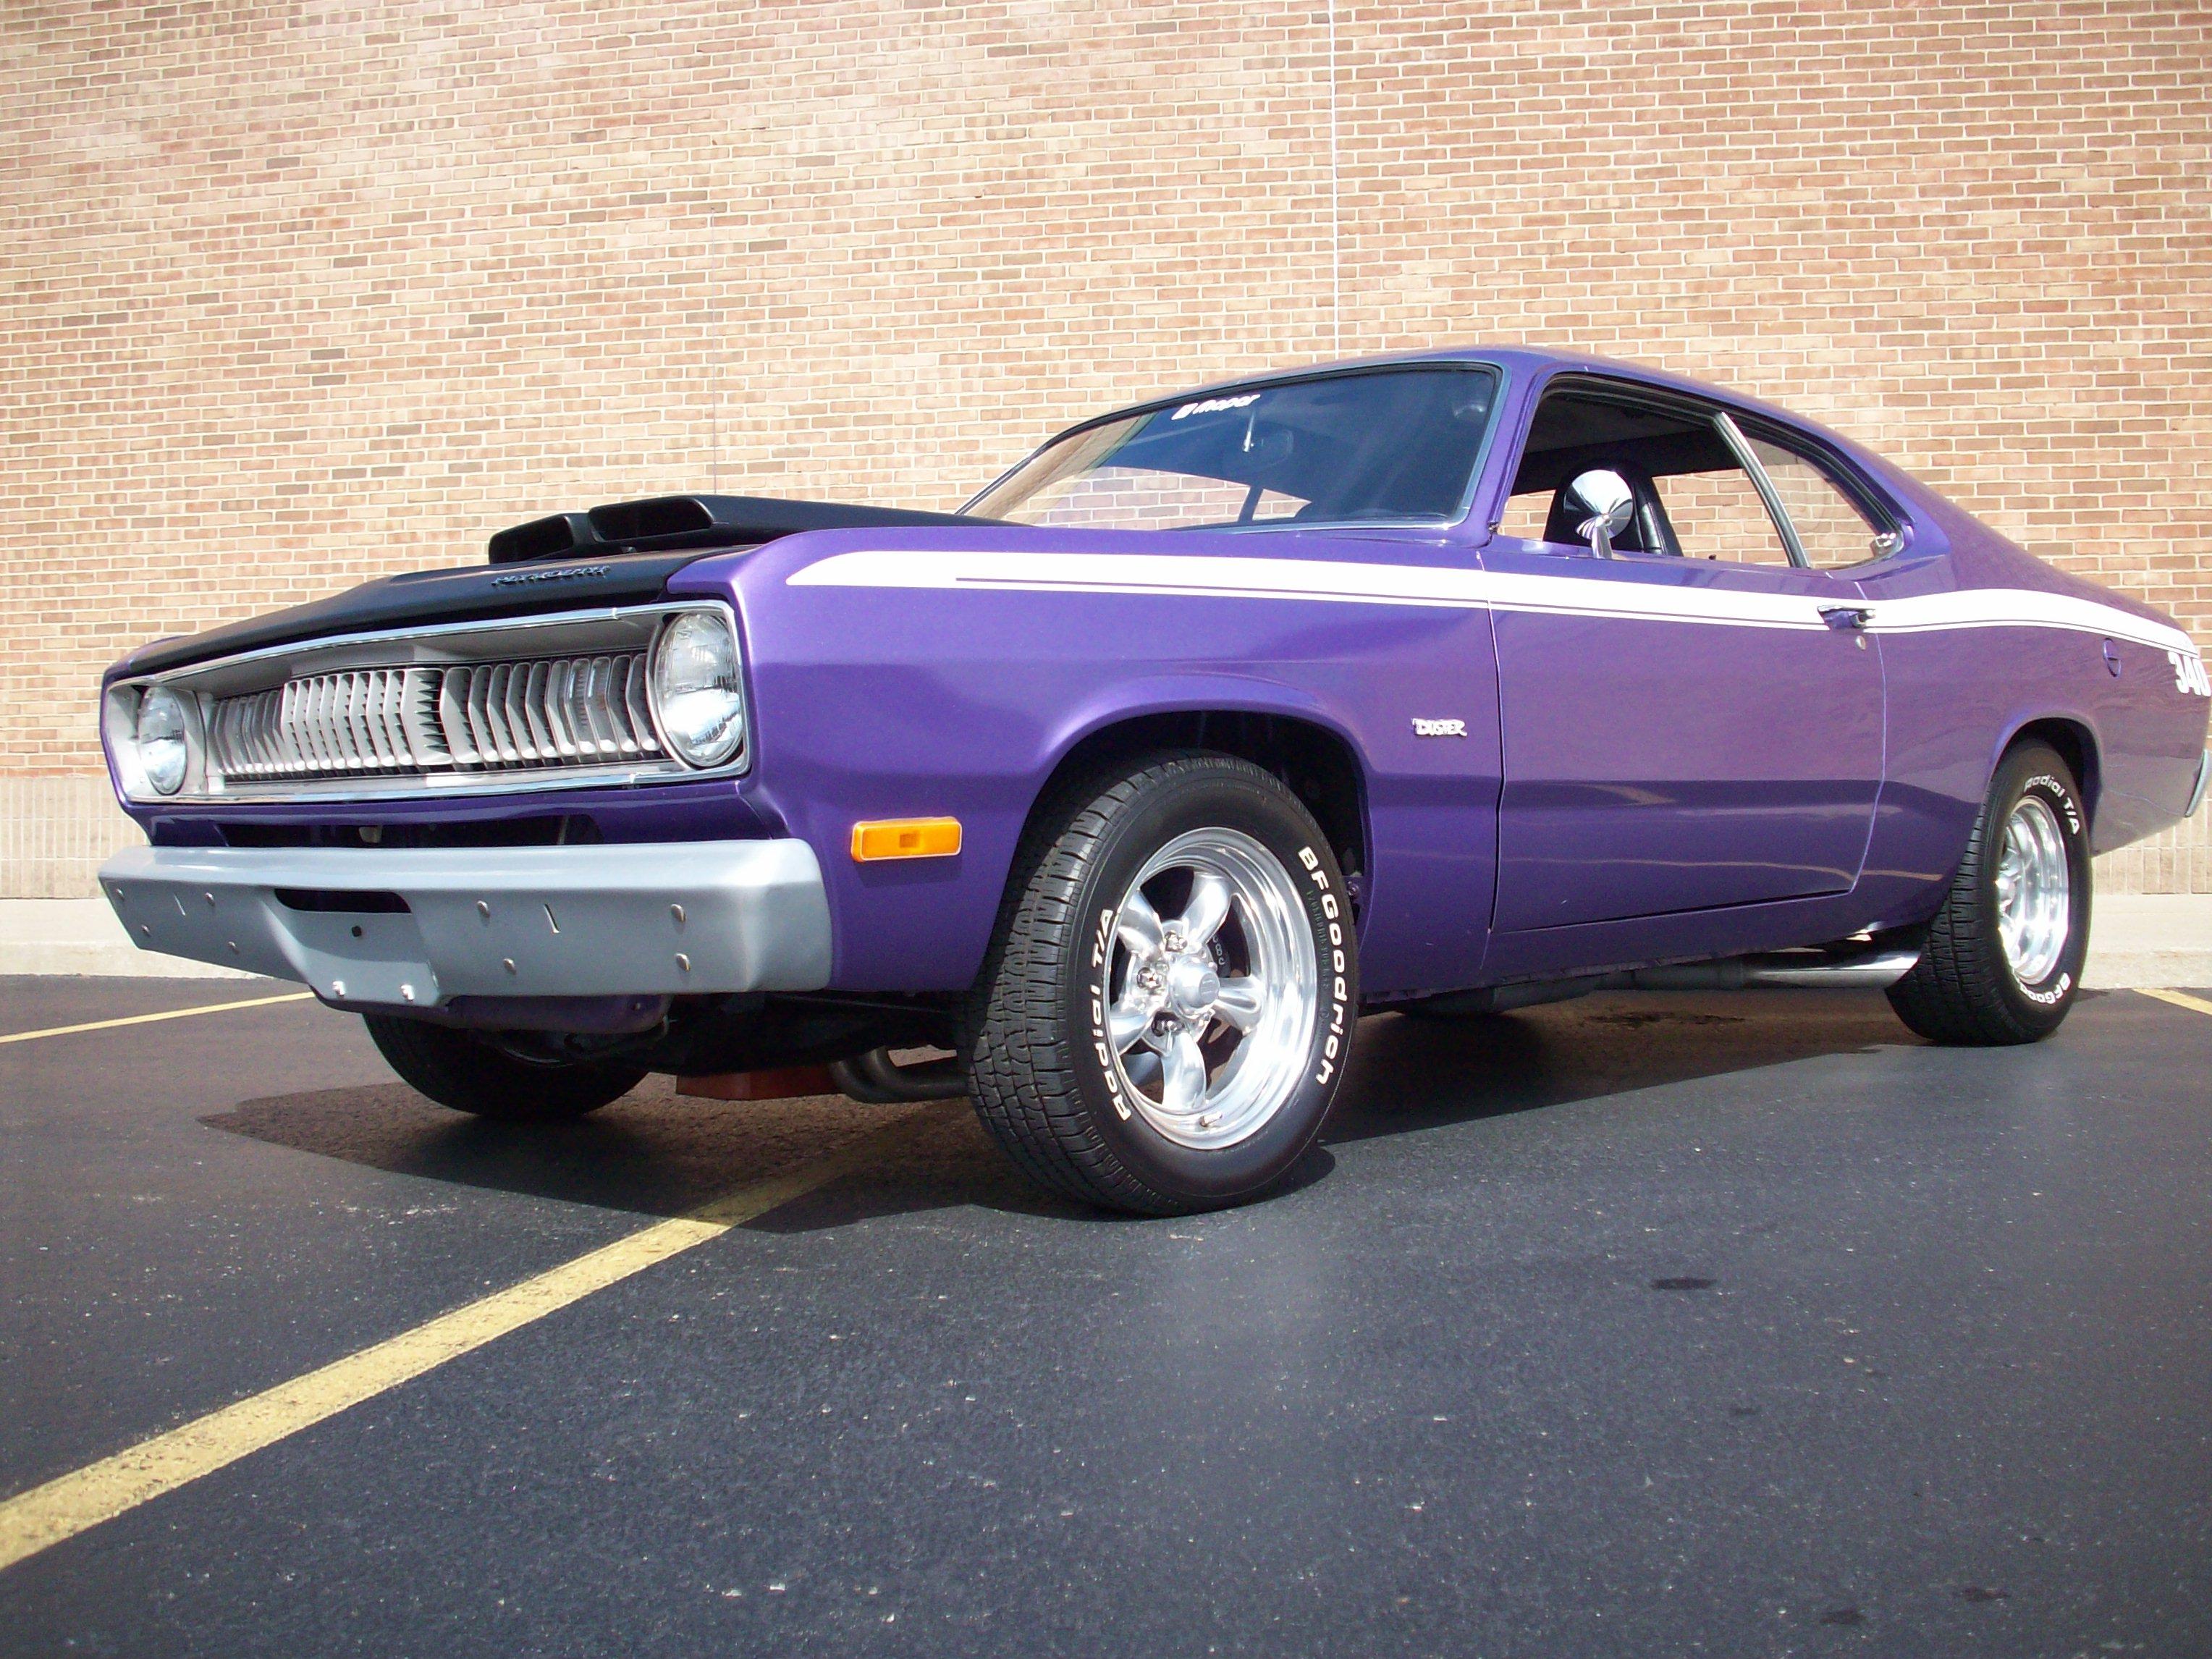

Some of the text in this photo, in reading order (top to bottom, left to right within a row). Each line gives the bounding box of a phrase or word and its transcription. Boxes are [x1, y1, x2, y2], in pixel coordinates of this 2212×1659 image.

[2167, 651, 2211, 697] 340
[2024, 774, 2080, 835] Radial T/A
[1090, 908, 1131, 1120] Radial T/A
[1298, 846, 1348, 1084] BFGoodrich
